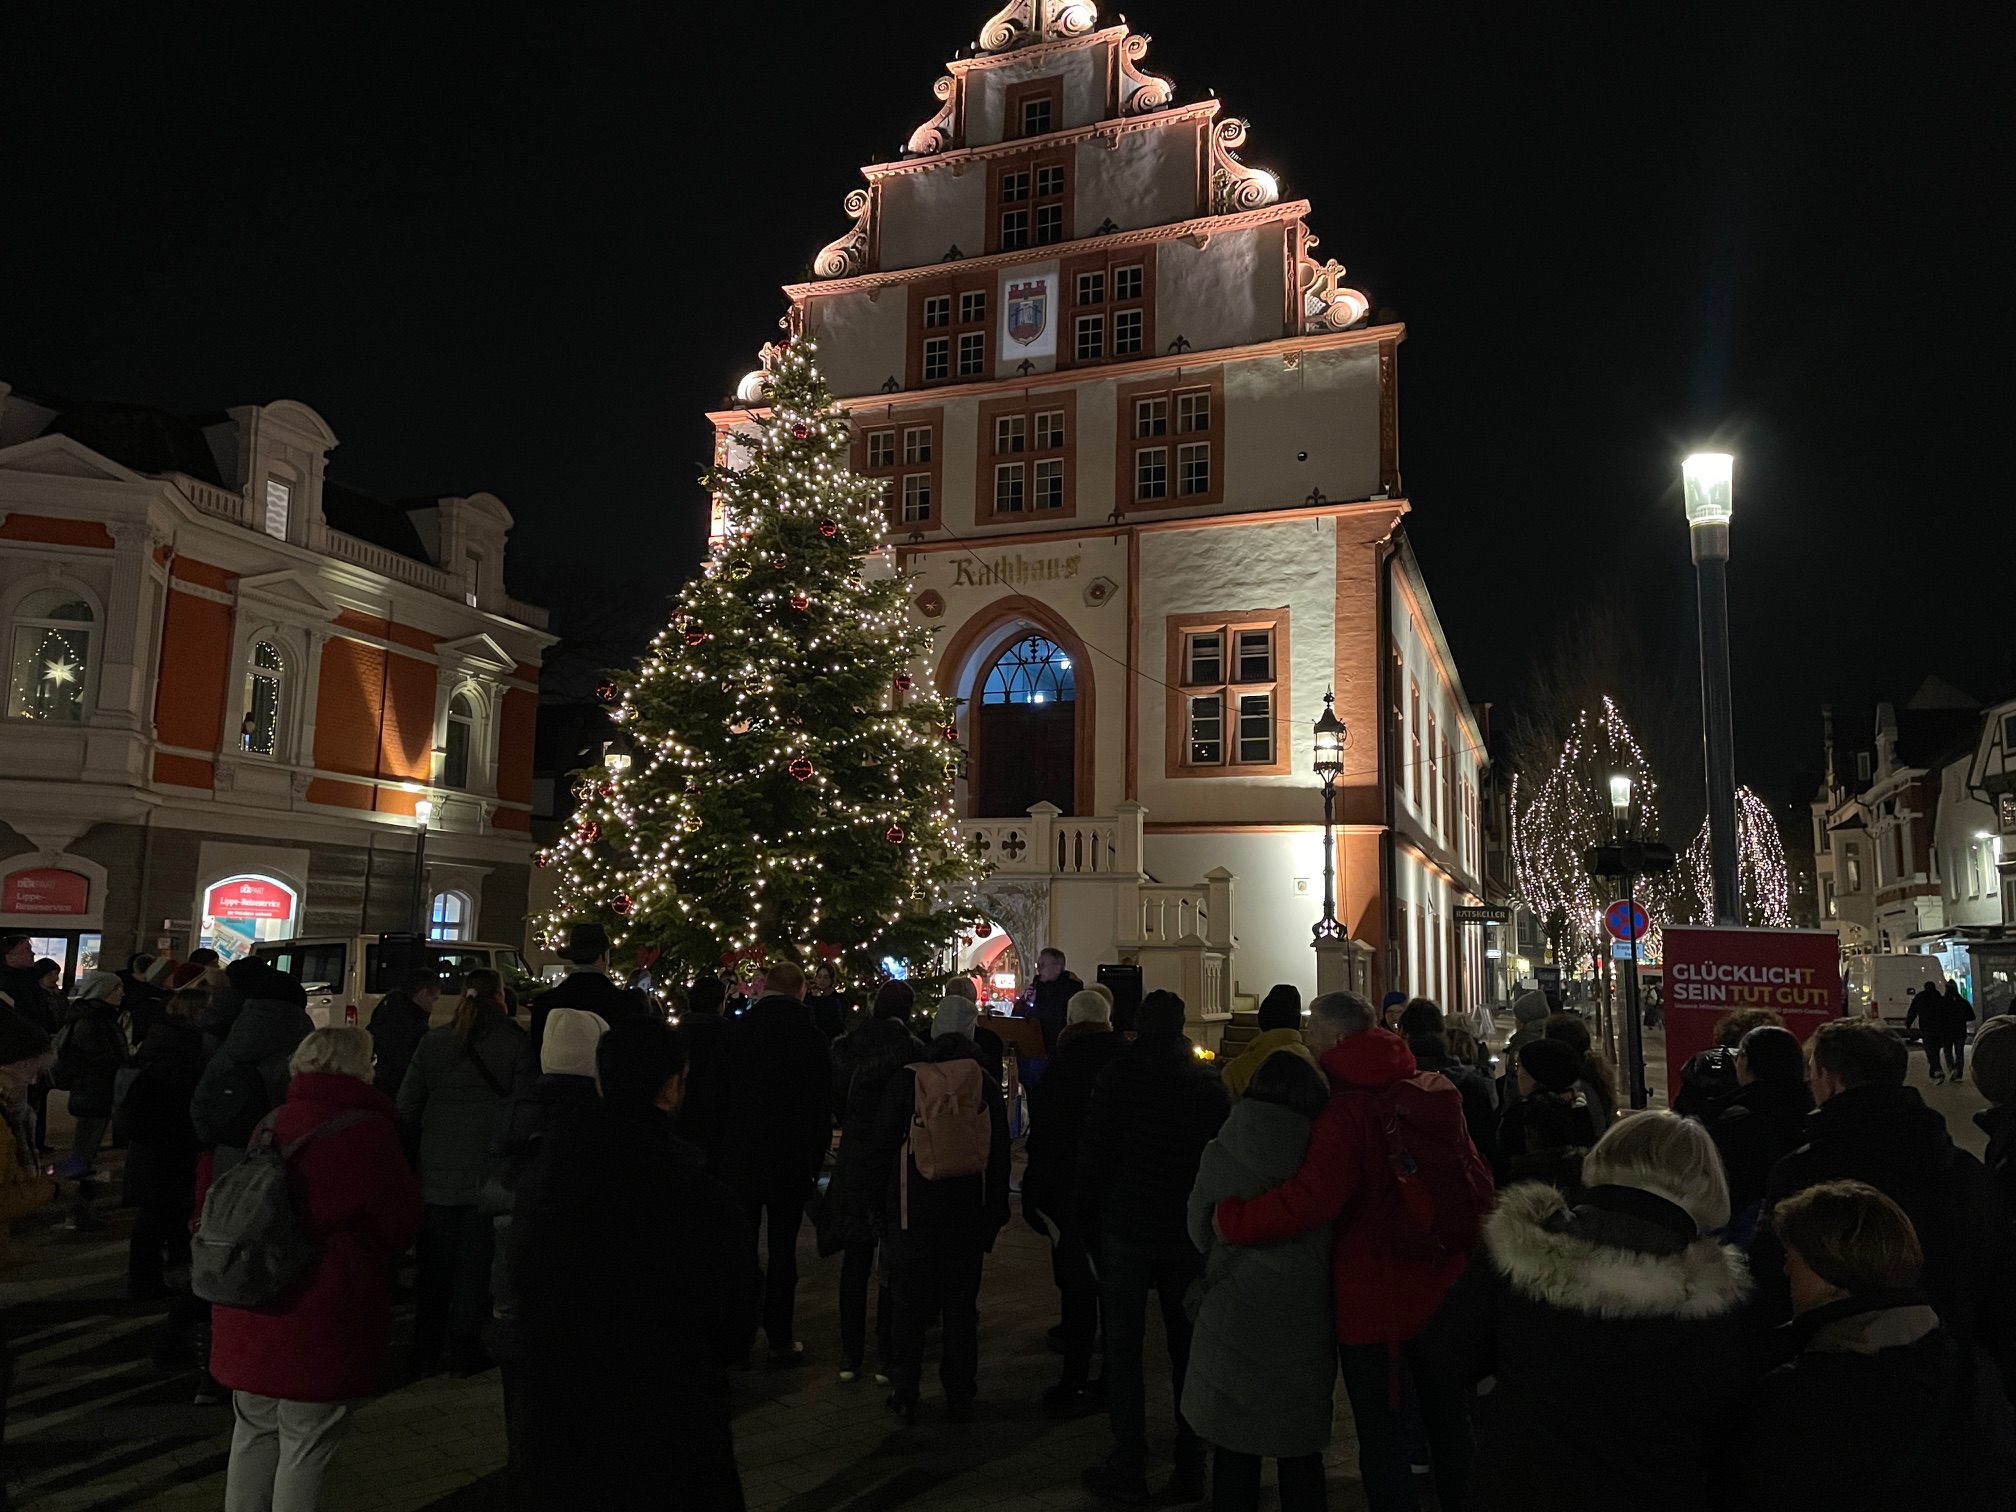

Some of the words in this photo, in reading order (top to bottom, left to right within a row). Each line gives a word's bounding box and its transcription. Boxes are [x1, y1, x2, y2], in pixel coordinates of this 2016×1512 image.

[949, 554, 1081, 588] Rathhaus
[16, 892, 47, 902] Lippe-
[219, 897, 281, 908] Lippe-Reiseservice
[15, 902, 72, 912] Reiseservice
[1456, 910, 1506, 918] RATSKELLER
[1672, 960, 1815, 985] GLÜCKLICHT
[1673, 983, 1726, 1001] SEIN
[1728, 985, 1773, 1004] TUT
[1776, 987, 1829, 1006] GUT!
